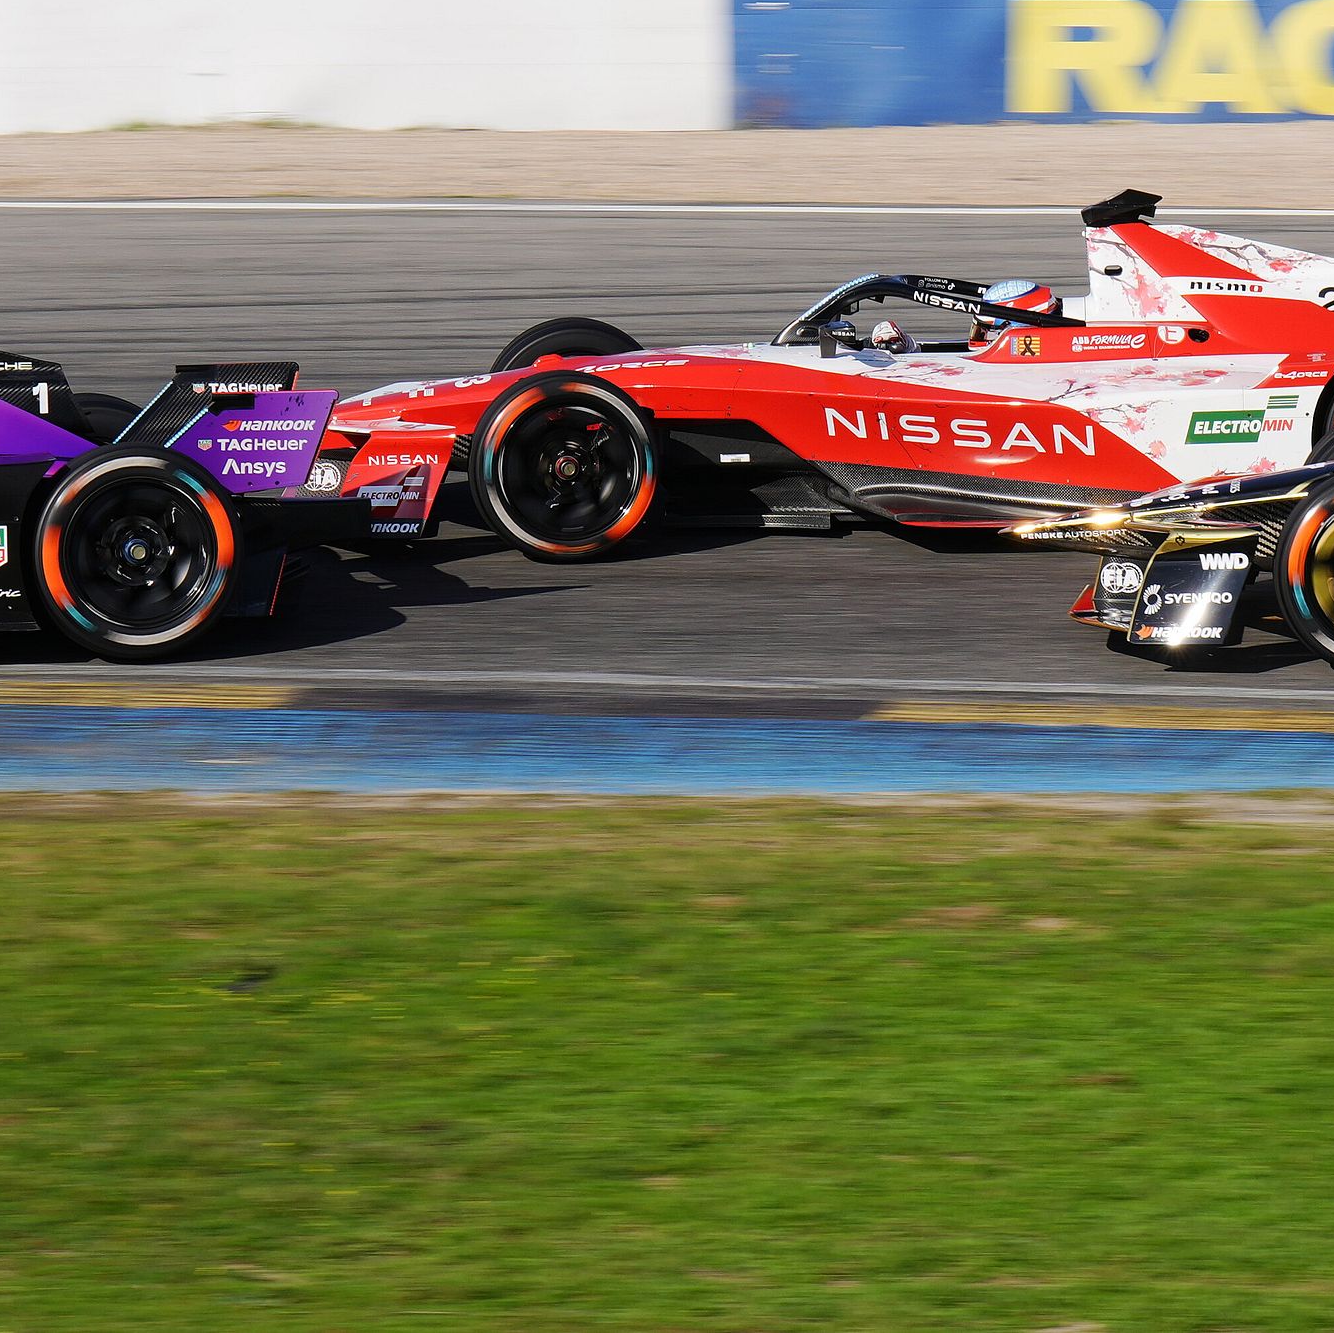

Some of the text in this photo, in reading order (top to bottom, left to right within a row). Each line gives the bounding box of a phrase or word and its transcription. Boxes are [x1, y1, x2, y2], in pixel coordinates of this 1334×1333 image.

[913, 290, 981, 314] NISSAN
[32, 382, 49, 414] 1
[824, 407, 1096, 457] NISSAN
[221, 458, 287, 477] Ansys
[368, 454, 439, 467] NISSAN
[1199, 553, 1250, 570] WWD
